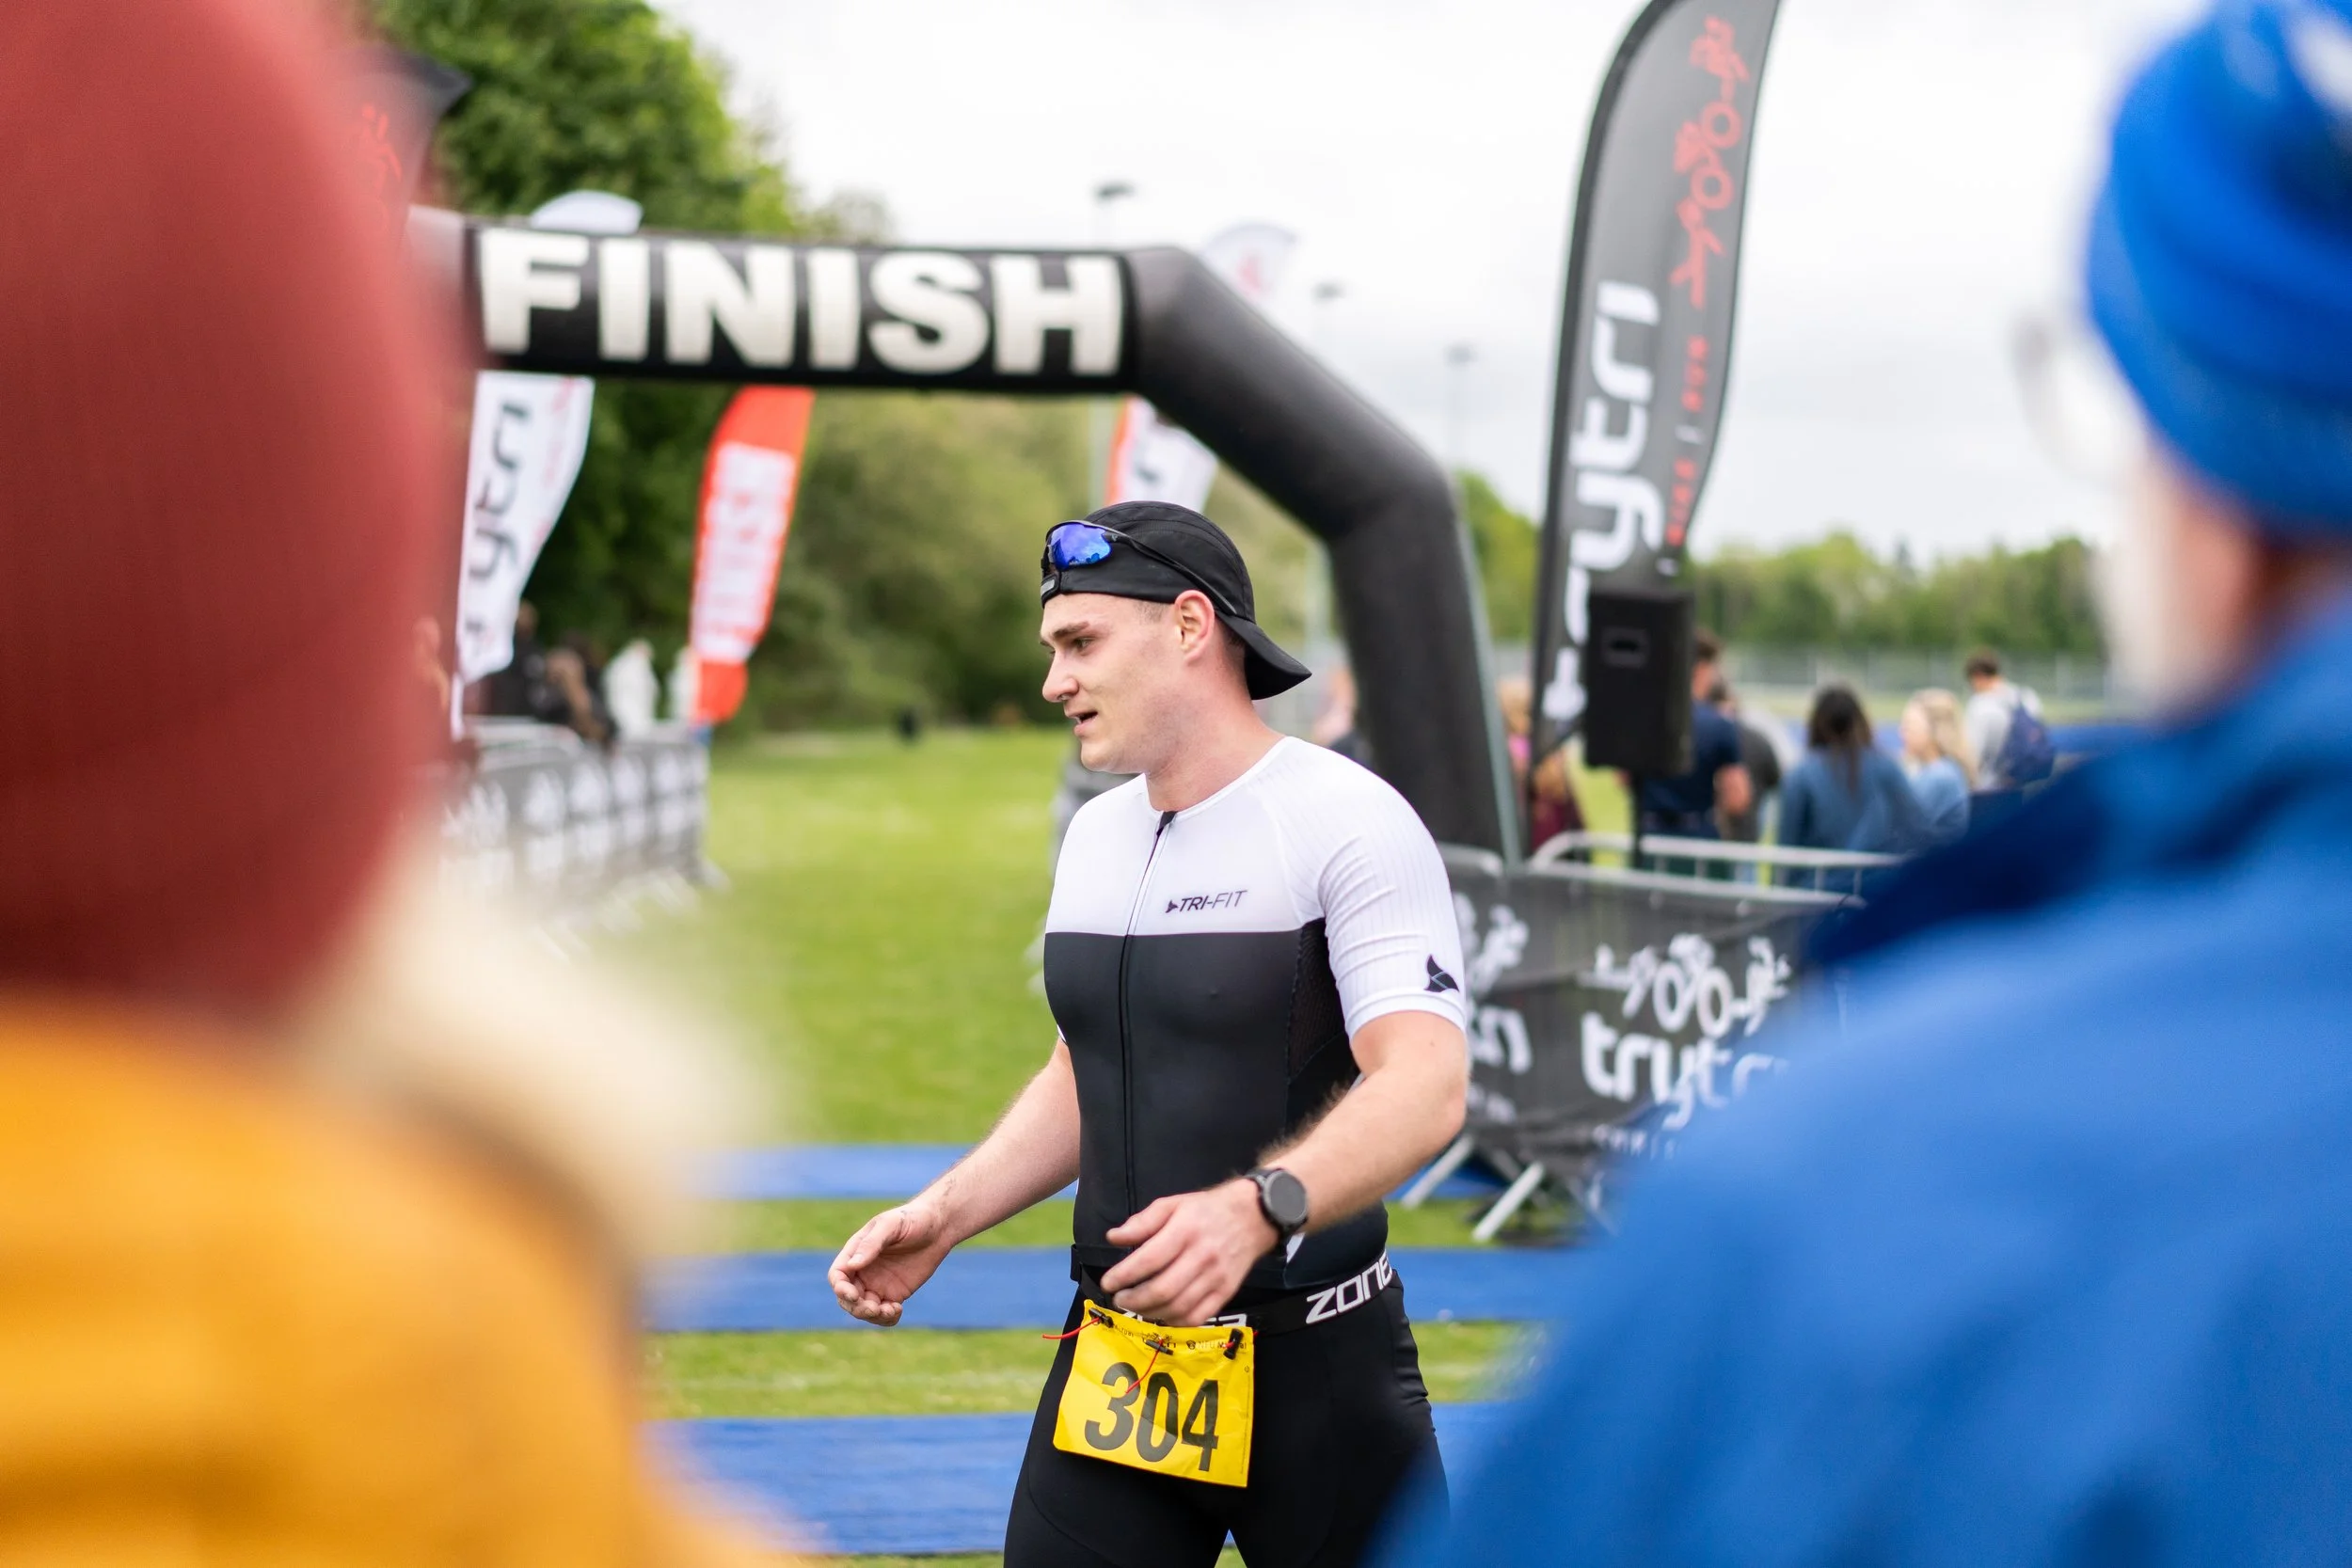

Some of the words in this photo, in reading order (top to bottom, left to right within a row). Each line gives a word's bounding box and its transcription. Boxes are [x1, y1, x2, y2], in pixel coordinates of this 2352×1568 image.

[480, 227, 1125, 375] FINISH
[1179, 889, 1248, 912] TRI-FIT
[1084, 1361, 1220, 1472] 304
